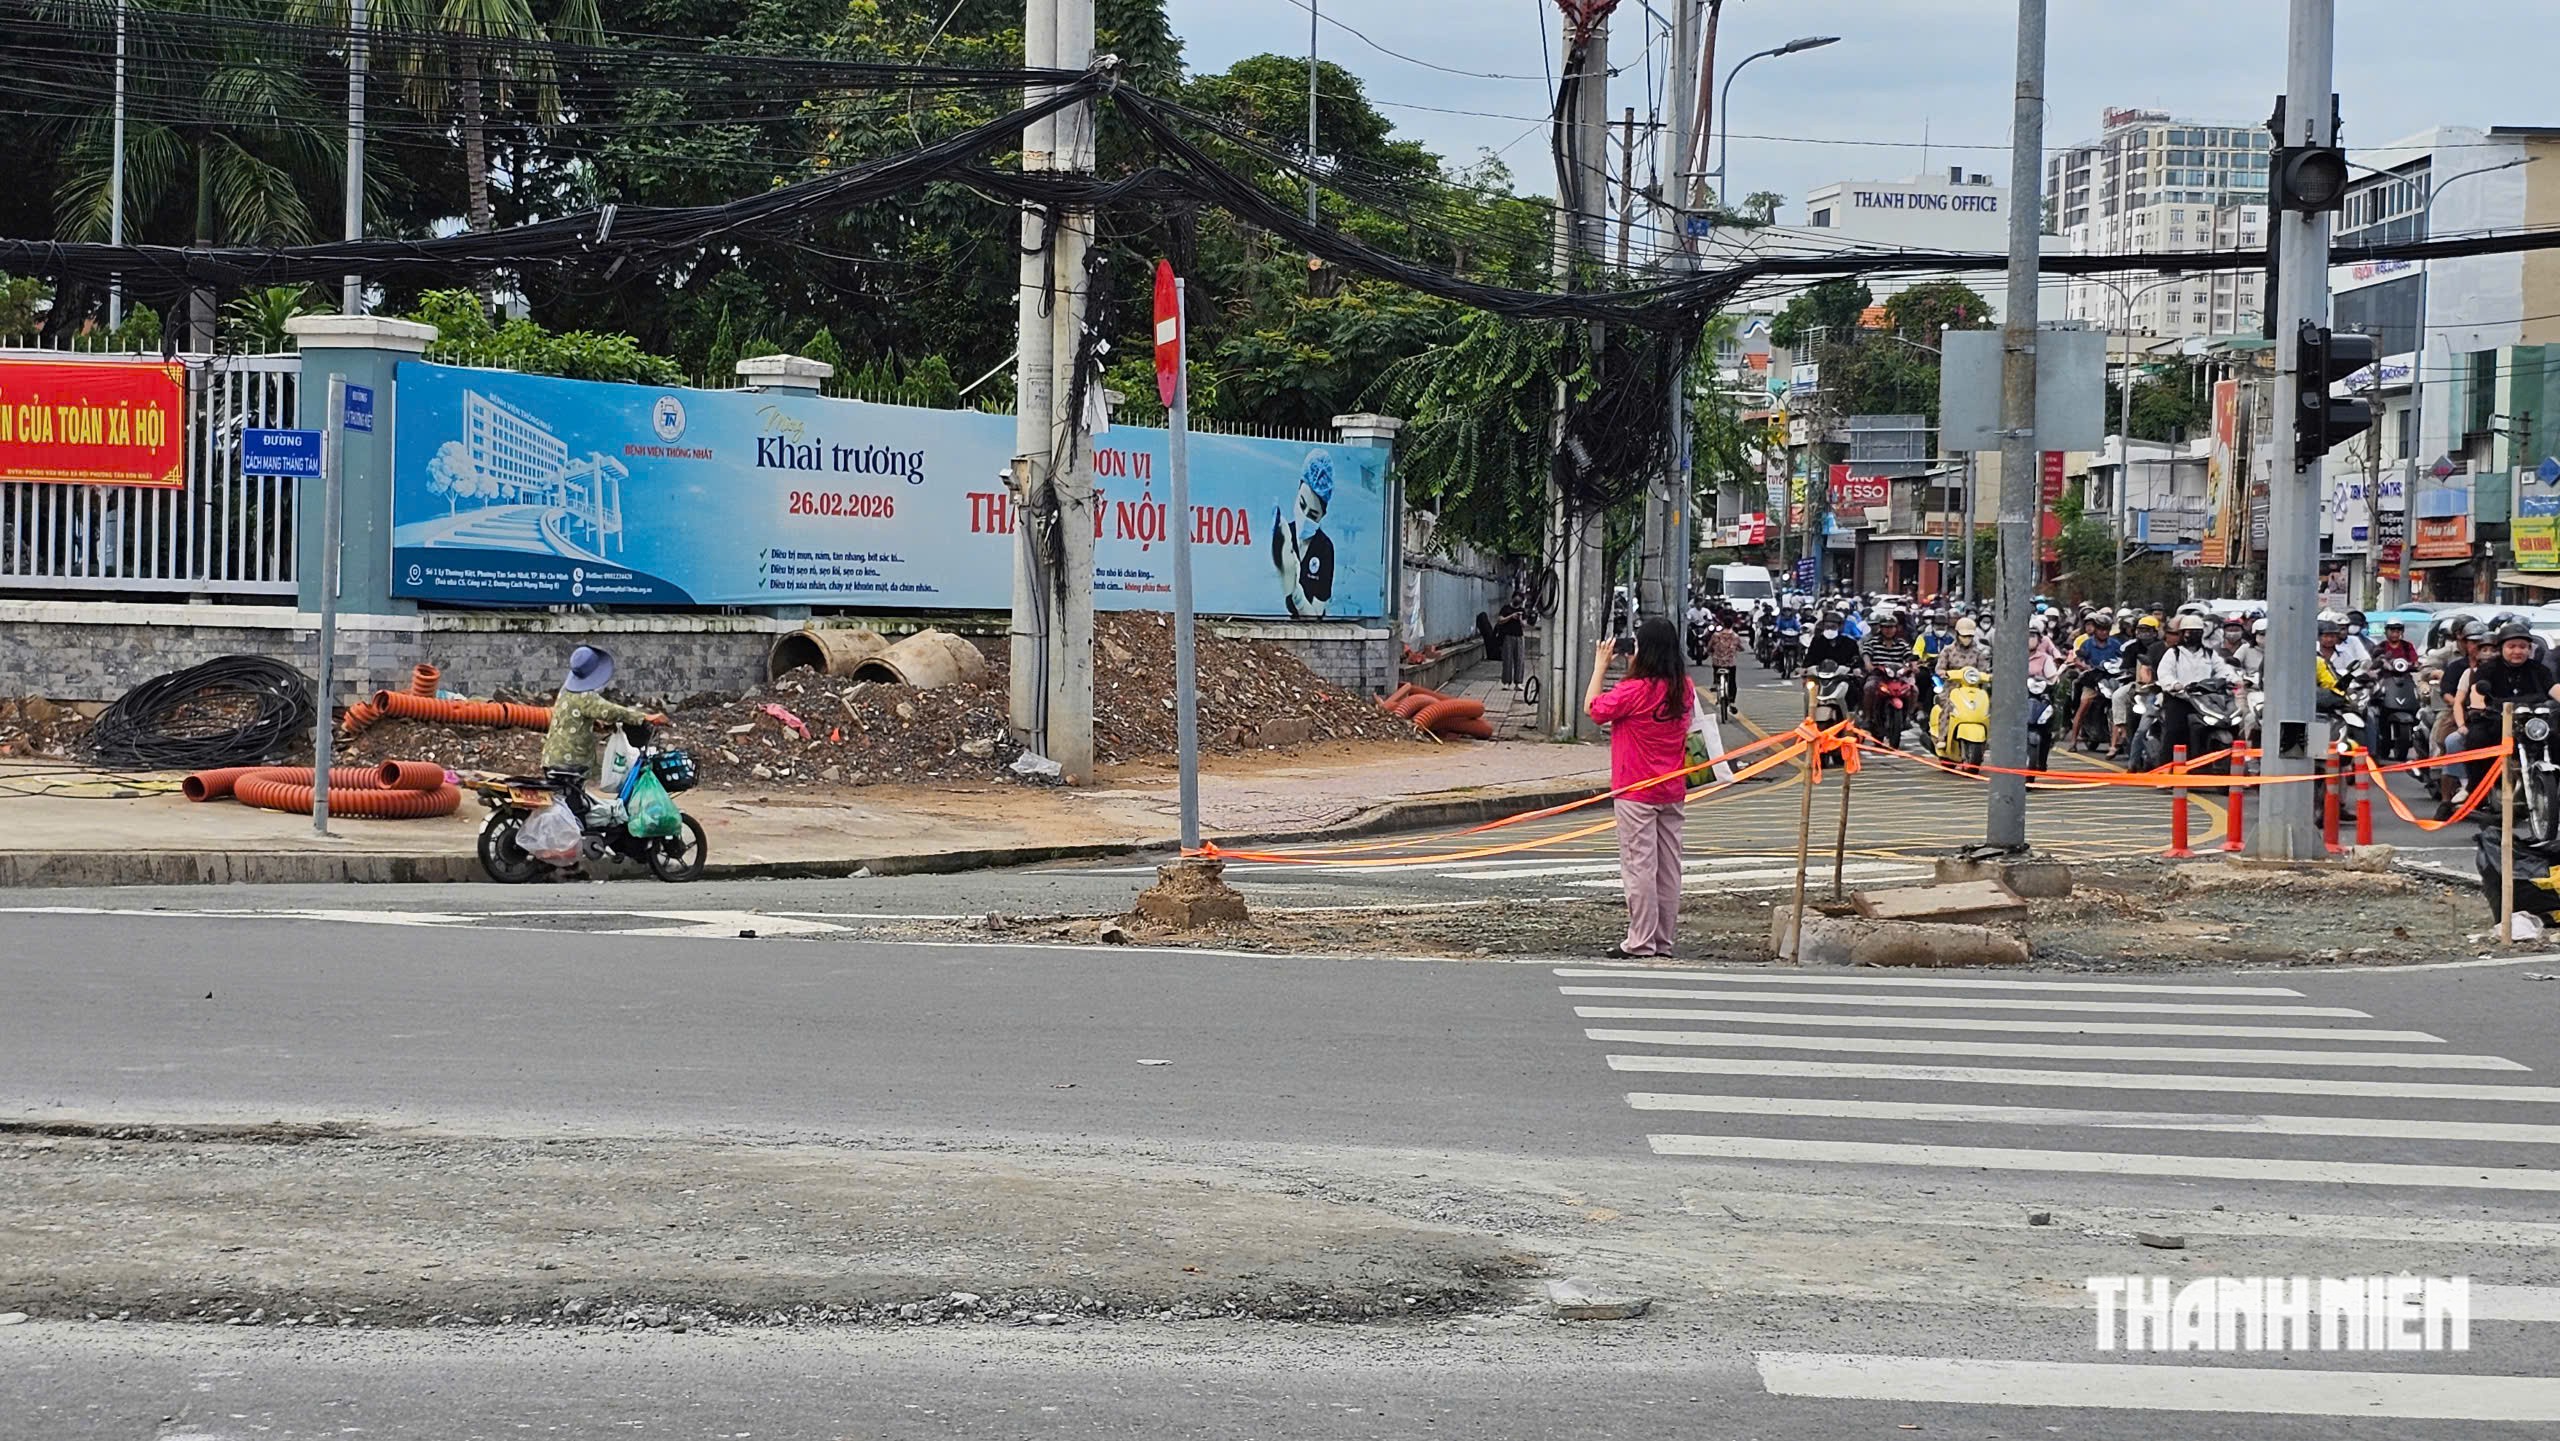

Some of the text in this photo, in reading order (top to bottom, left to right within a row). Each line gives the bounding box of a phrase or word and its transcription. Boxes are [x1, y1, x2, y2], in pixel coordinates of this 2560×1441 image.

[1853, 191, 1997, 212] THANH DUNG OFFICE
[0, 386, 165, 456] N CỦA TOÀN XÃ HỘI
[263, 433, 302, 447] ĐƯỜNG
[624, 444, 646, 458] BỆNH
[646, 445, 666, 459] VIỆN
[245, 451, 319, 474] CÁCH MẠNG THÁNG TÁM
[756, 435, 925, 485] Khai trương
[1132, 452, 1151, 487] VỊ
[789, 491, 894, 519] 26.02.2026
[966, 492, 1015, 535] TH
[1117, 491, 1166, 552] NỘI
